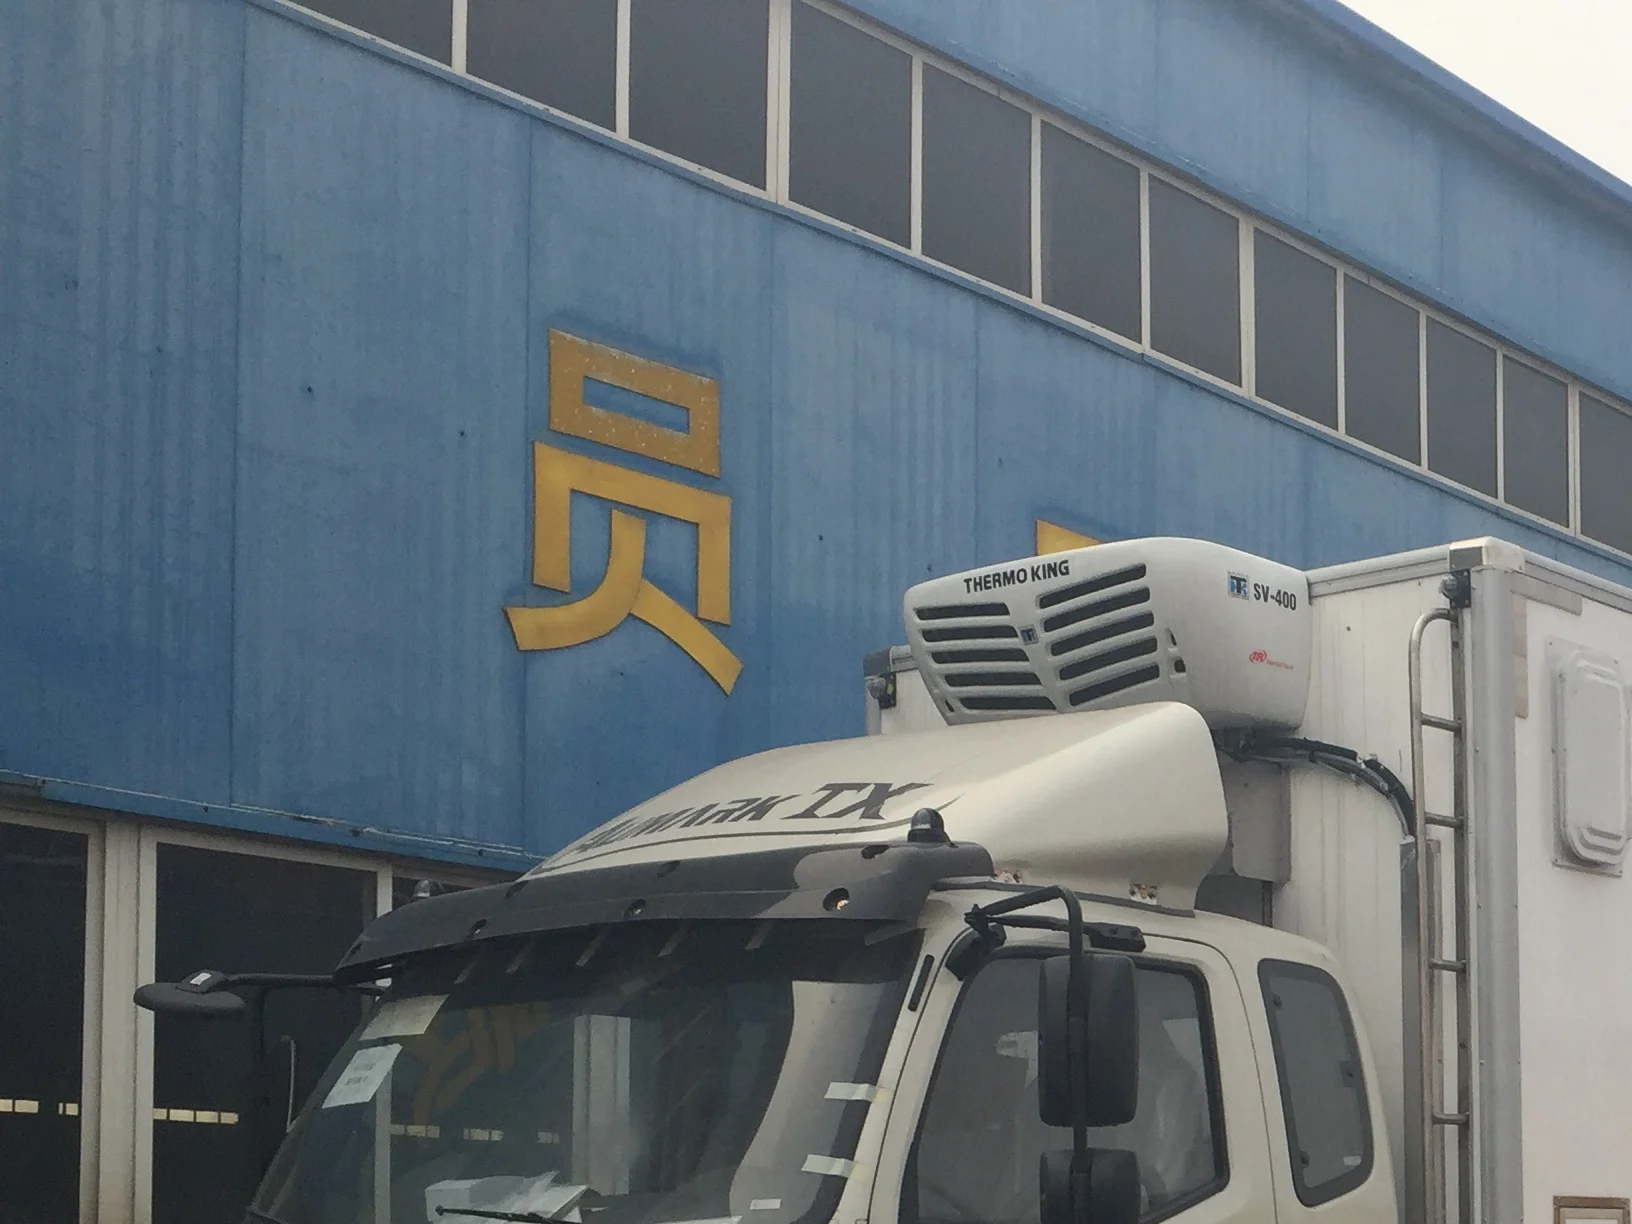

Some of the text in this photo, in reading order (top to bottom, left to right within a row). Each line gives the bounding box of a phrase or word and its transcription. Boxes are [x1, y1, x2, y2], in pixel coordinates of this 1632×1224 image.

[504, 328, 743, 696] 员
[963, 559, 1070, 594] THERMO KING
[1253, 582, 1297, 611] SV-400
